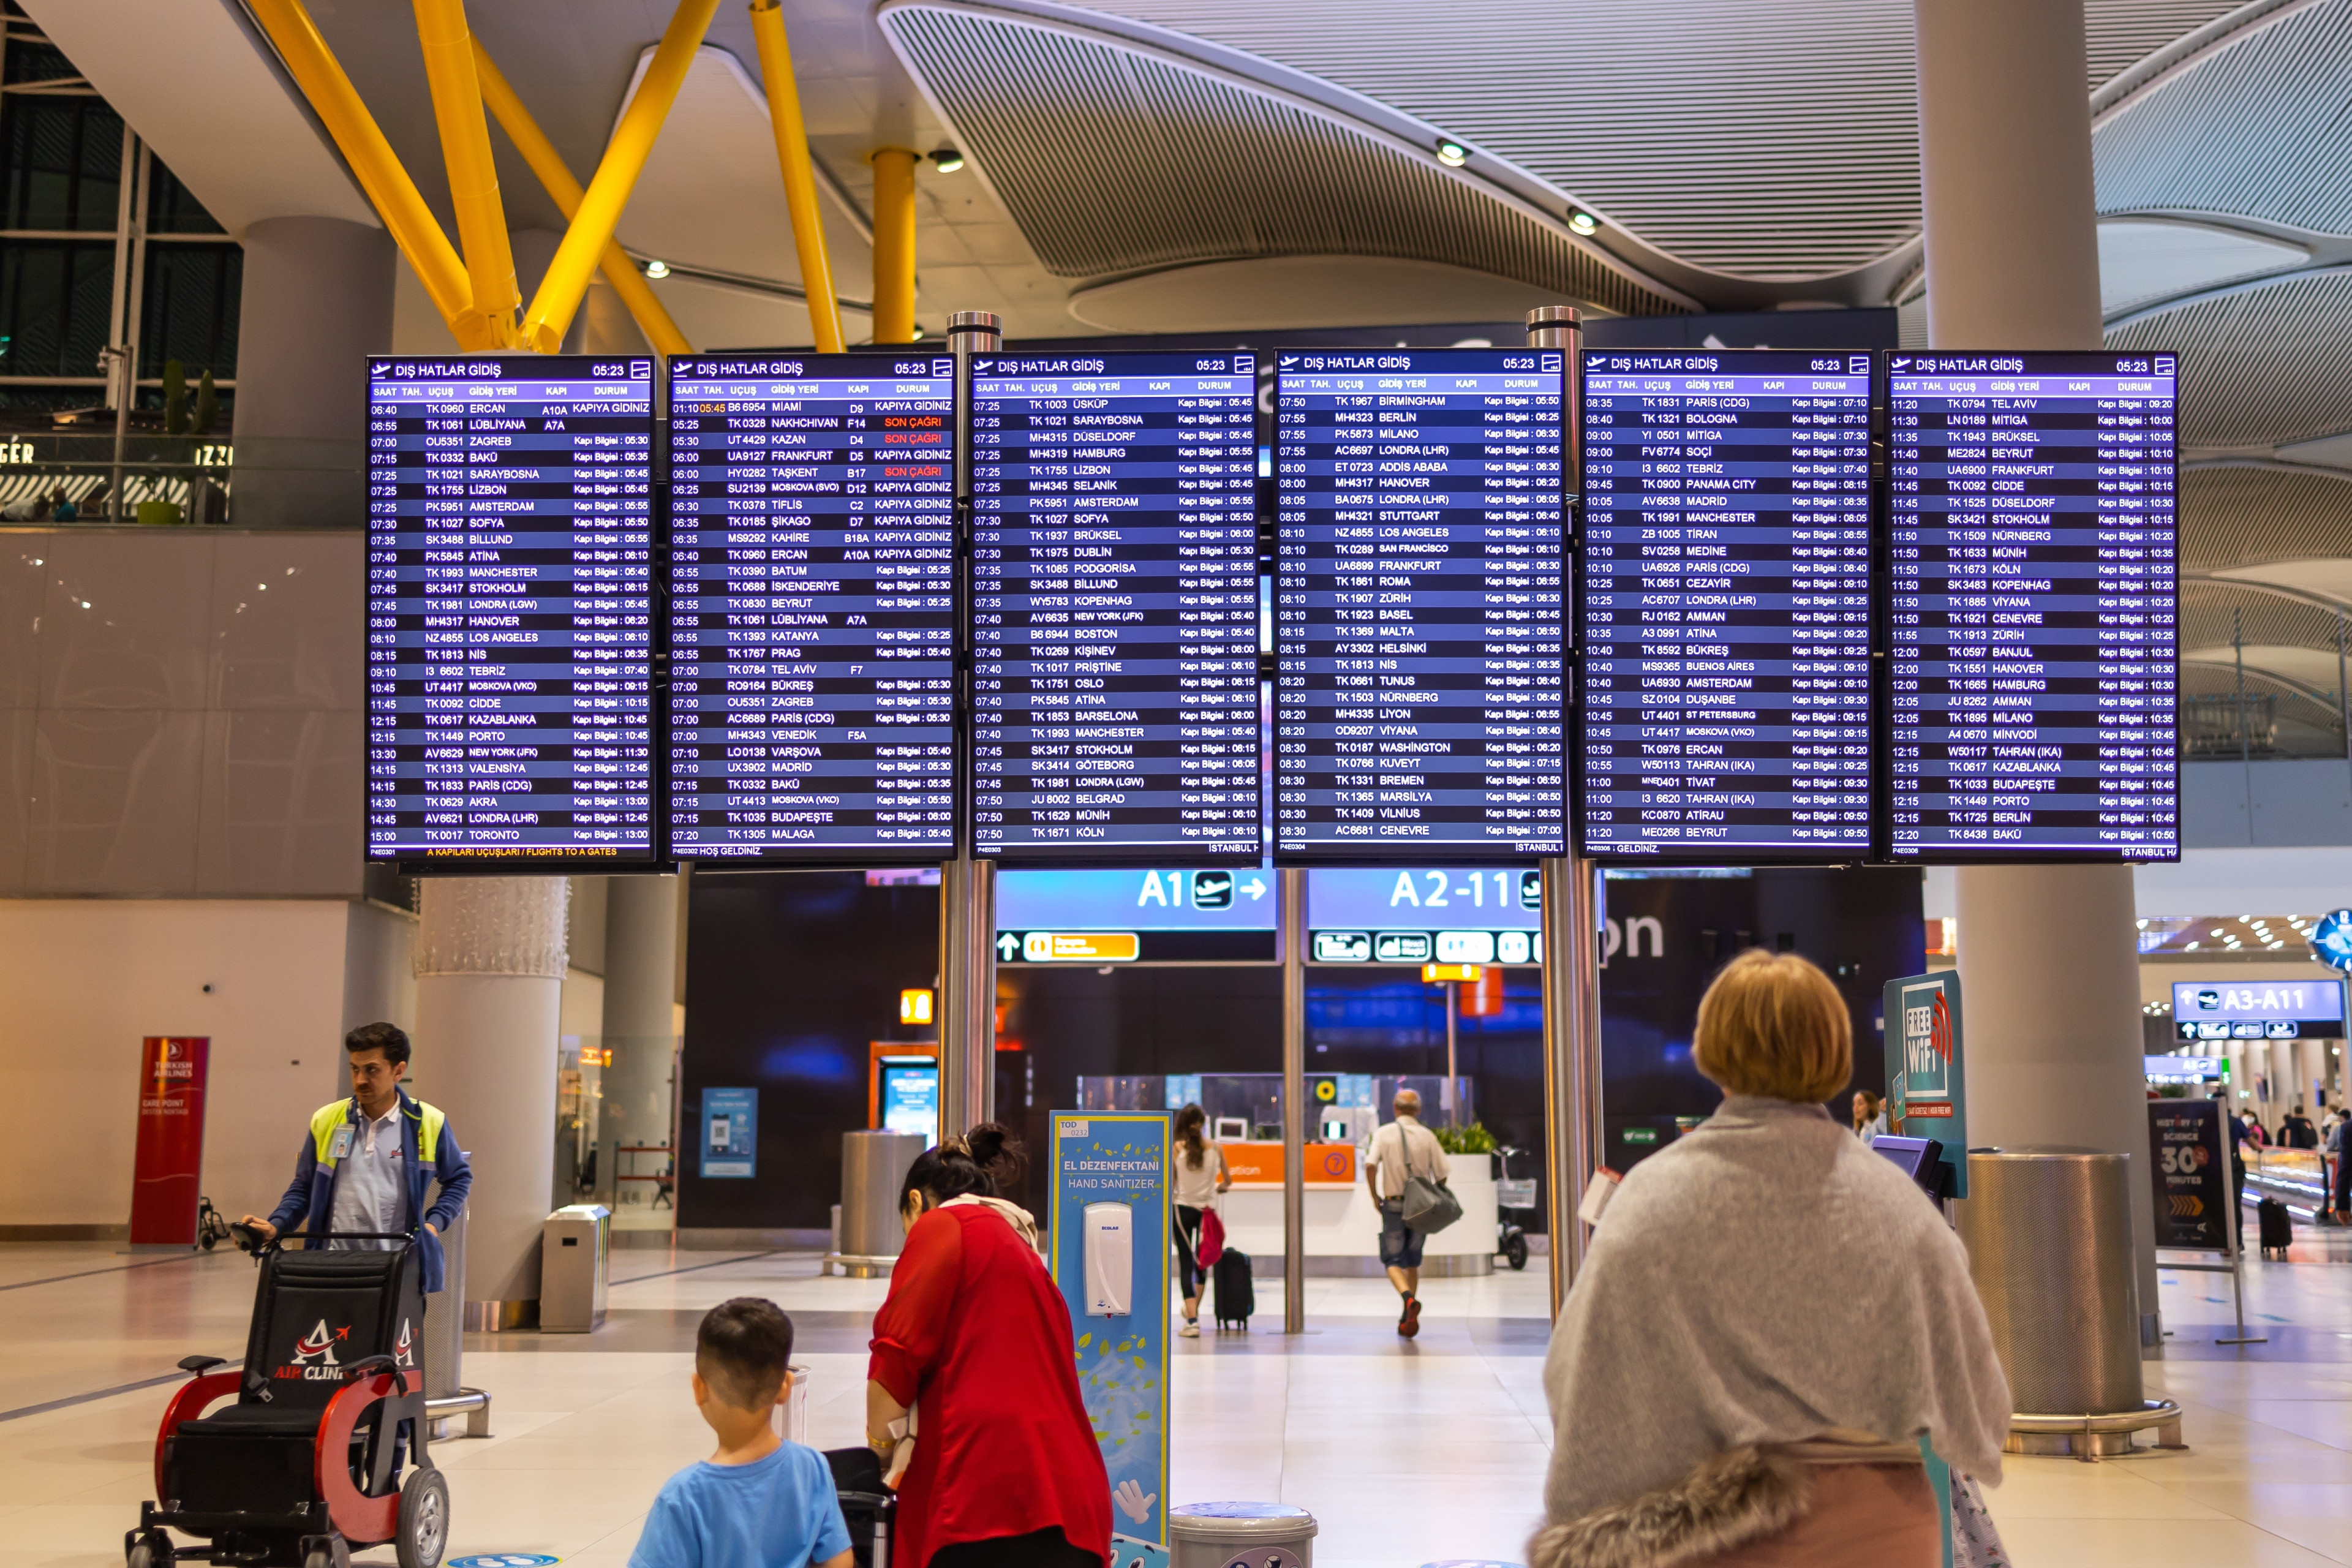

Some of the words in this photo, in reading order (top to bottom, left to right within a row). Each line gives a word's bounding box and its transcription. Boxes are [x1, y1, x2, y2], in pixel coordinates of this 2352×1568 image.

[698, 364, 717, 377] DIŞ
[721, 363, 767, 374] HATLAR
[771, 361, 803, 376] GİDİŞ
[895, 363, 926, 374] 05:23
[998, 361, 1019, 374] DIŞ
[1022, 361, 1068, 372] HATLAR
[1071, 359, 1104, 374] GİDİŞ
[1196, 360, 1225, 371] 05:23
[1304, 357, 1324, 371] DIŞ
[1327, 357, 1374, 368] HATLAR
[1378, 356, 1411, 371] GİDİŞ
[1503, 358, 1534, 369] 05:23
[1611, 358, 1631, 371] DIŞ
[1635, 358, 1682, 369] HATLAR
[1685, 356, 1718, 372] GİDİŞ
[1811, 360, 1840, 371] 05:23
[1916, 360, 1936, 373] DIŞ
[1939, 360, 1987, 371] HATLAR
[1990, 358, 2023, 373] GİDİŞ
[2116, 361, 2148, 372] 05:23
[396, 365, 416, 379] DIŞ
[419, 365, 466, 376] HATLAR
[469, 363, 502, 378] GİDİŞ
[593, 365, 624, 376] 05:23
[374, 386, 398, 396] SAAT
[401, 386, 423, 396] TAH.
[428, 386, 455, 398] UÇUŞ
[469, 386, 494, 397] GİDİŞ
[496, 386, 518, 396] YERİ
[545, 386, 567, 396] KAPI
[594, 385, 628, 396] DURUM
[1280, 398, 1306, 407] 07:50
[1379, 395, 1446, 406] BİRMİNGHAM
[371, 405, 397, 415] 06:40
[470, 404, 505, 413] ERCAN
[542, 405, 568, 415] A10A
[573, 403, 610, 413] KAPIYA
[611, 402, 650, 413] GİDİNİZ
[673, 420, 699, 429] 05:25
[772, 418, 838, 428] NAKHCHIVAN
[848, 419, 866, 428] F14
[884, 418, 907, 427] SON
[909, 416, 941, 429] ÇAĞRI
[1586, 415, 1613, 424] 08:40
[1686, 414, 1738, 424] BOLOGNA
[371, 438, 397, 447] 07:00
[426, 437, 463, 447] OU5351
[469, 436, 512, 446] ZAGREB
[574, 436, 593, 447] Kapı
[595, 436, 619, 447] Bilgisi
[625, 435, 649, 445] 05:30
[974, 434, 1000, 443] 07:25
[1029, 432, 1068, 442] MH4315
[1073, 431, 1136, 442] DÜSELDORF
[1891, 432, 1918, 442] 11:35
[1992, 431, 2040, 442] BRÜKSEL
[673, 453, 699, 462] 06:00
[728, 451, 766, 461] UA9127
[772, 451, 834, 461] FRANKFURT
[850, 451, 864, 461] D5
[875, 450, 912, 460] KAPIYA
[914, 449, 952, 459] GİDİNİZ
[371, 471, 397, 481] 07:25
[470, 469, 540, 479] SARAYBOSNA
[1280, 512, 1306, 522] 08:05
[1379, 511, 1440, 521] STUTTGART
[1892, 549, 1918, 558] 11:50
[1992, 547, 2026, 557] MÜNİH
[1586, 579, 1613, 588] 10:25
[1686, 578, 1731, 588] CEZAYİR
[975, 598, 1001, 608] 07:35
[1030, 597, 1069, 606] WY5783
[1074, 595, 1133, 606] KOPENHAG
[371, 651, 396, 660] 08:15
[469, 649, 487, 660] NİS
[975, 648, 1001, 657] 07:40
[1074, 645, 1116, 658] KİŞİNEV
[1280, 644, 1306, 654] 08:15
[1379, 643, 1427, 653] HELSİNKİ
[1586, 695, 1613, 704] 10:45
[1686, 695, 1736, 706] DUŞANBE
[1893, 730, 1918, 739] 12:15
[1993, 728, 2037, 740] MİNVODİ
[1280, 744, 1306, 753] 08:30
[1379, 741, 1450, 752] WASHİNGTON
[673, 814, 698, 823] 07:15
[772, 812, 834, 824] BUDAPEŞTE
[371, 832, 396, 841] 15:00
[469, 830, 520, 840] TORONTO
[976, 829, 1003, 839] 07:50
[1076, 826, 1104, 837] KÖLN
[1280, 826, 1306, 836] 08:30
[1379, 825, 1430, 835] CENEVRE
[1586, 827, 1612, 837] 11:20
[1686, 827, 1728, 837] BEYRUT
[1893, 830, 1919, 840] 12:20
[1993, 828, 2022, 839] BAKÜ
[426, 846, 435, 856] A
[434, 846, 477, 856] KAPILARI
[475, 846, 522, 858] UÇUŞLARI
[526, 846, 564, 856] FLIGHTS
[564, 846, 579, 856] TO
[578, 846, 587, 856] A
[586, 846, 619, 856] GATES
[699, 845, 720, 857] HOŞ
[720, 845, 764, 855] GELDİNİZ.
[1208, 843, 1251, 853] İSTANBUL
[1616, 844, 1659, 853] GELDİNİZ.
[1137, 869, 1182, 907] A1
[2224, 989, 2304, 1010] A3-A11
[1908, 1011, 1929, 1032] FREE
[1064, 1161, 1077, 1170] EL
[1080, 1161, 1159, 1170] DEZENFEKTANI
[2161, 1145, 2198, 1174] 30
[1068, 1178, 1098, 1188] HAND
[1101, 1178, 1155, 1189] SANITIZER
[274, 1365, 302, 1379] AIR
